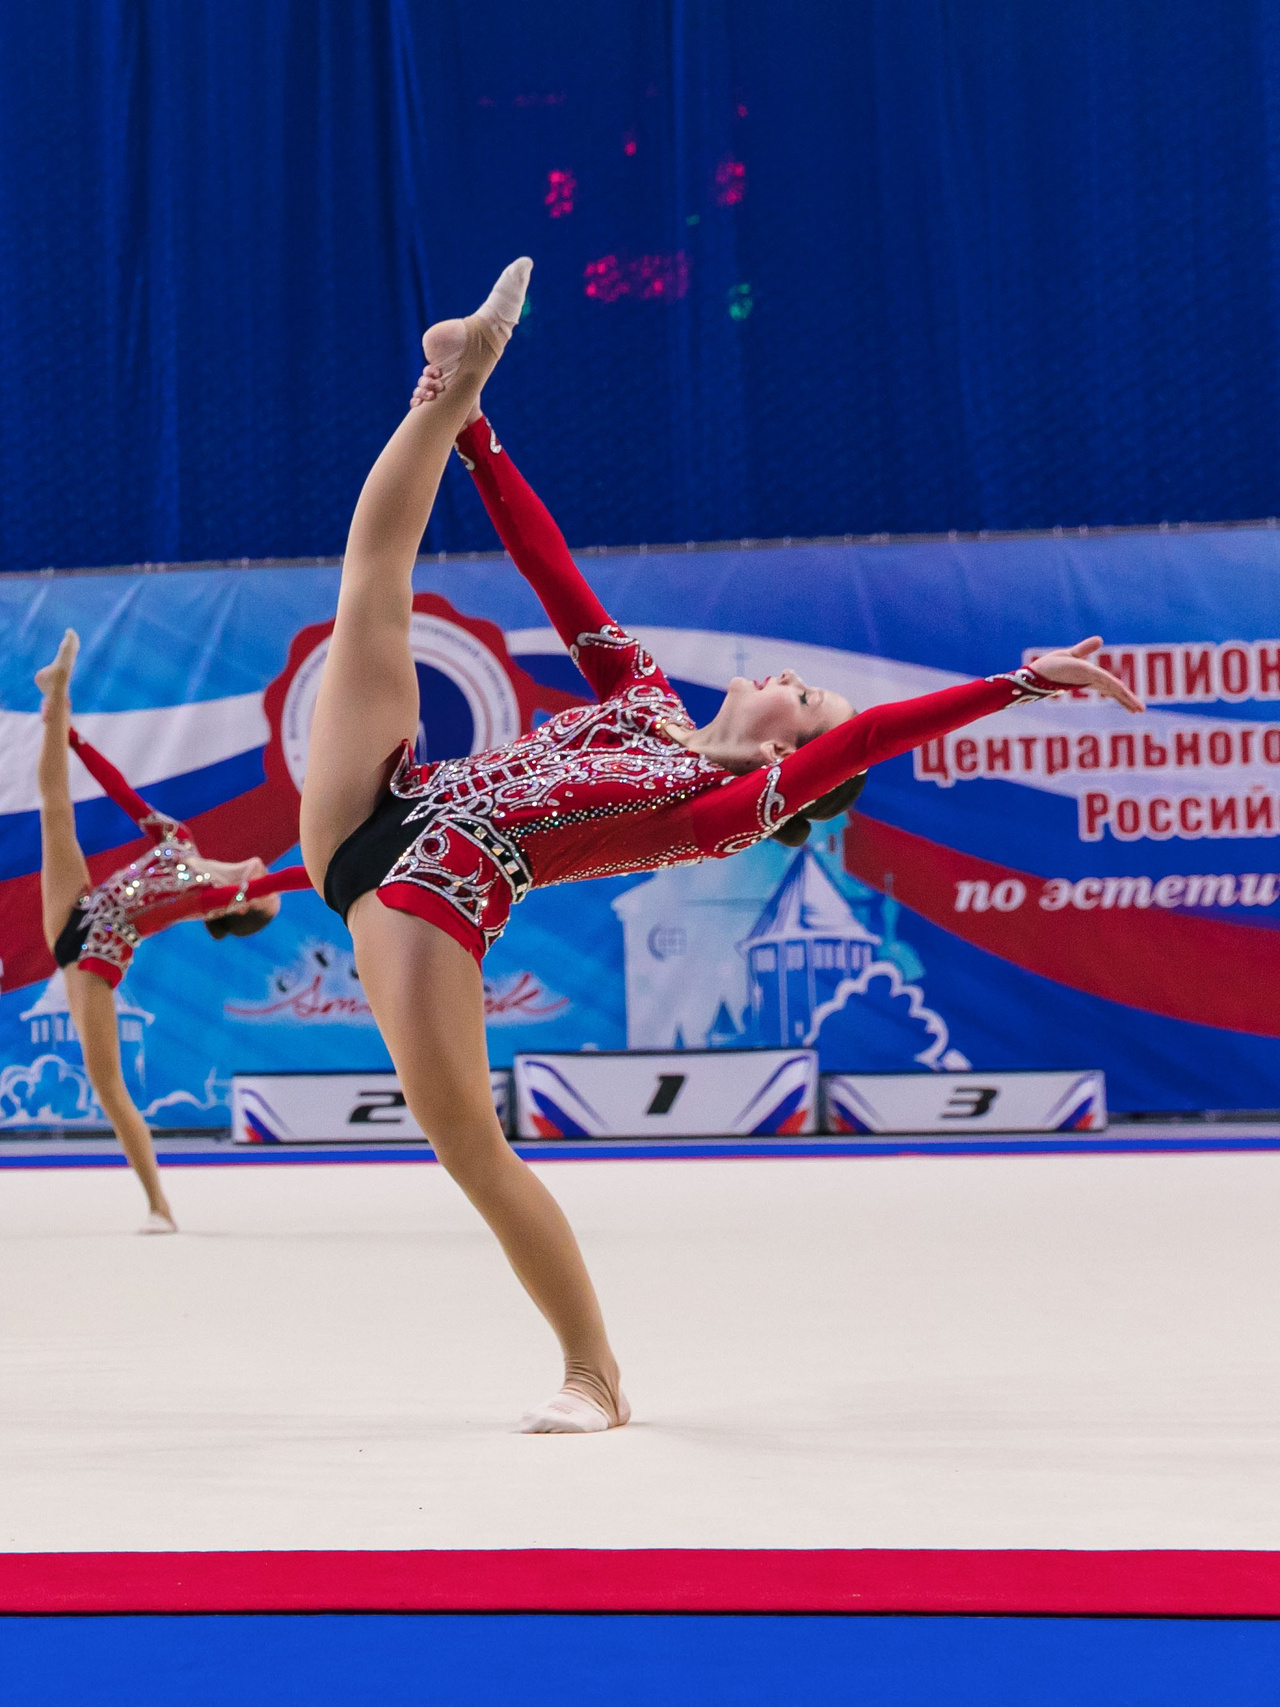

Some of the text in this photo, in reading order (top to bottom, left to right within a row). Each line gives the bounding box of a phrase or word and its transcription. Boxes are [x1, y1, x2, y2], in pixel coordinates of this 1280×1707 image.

[920, 728, 1280, 780] Центрального
[954, 879, 1027, 912] по
[349, 1090, 407, 1124] 2
[646, 1074, 686, 1116] 1
[940, 1087, 998, 1119] 3
